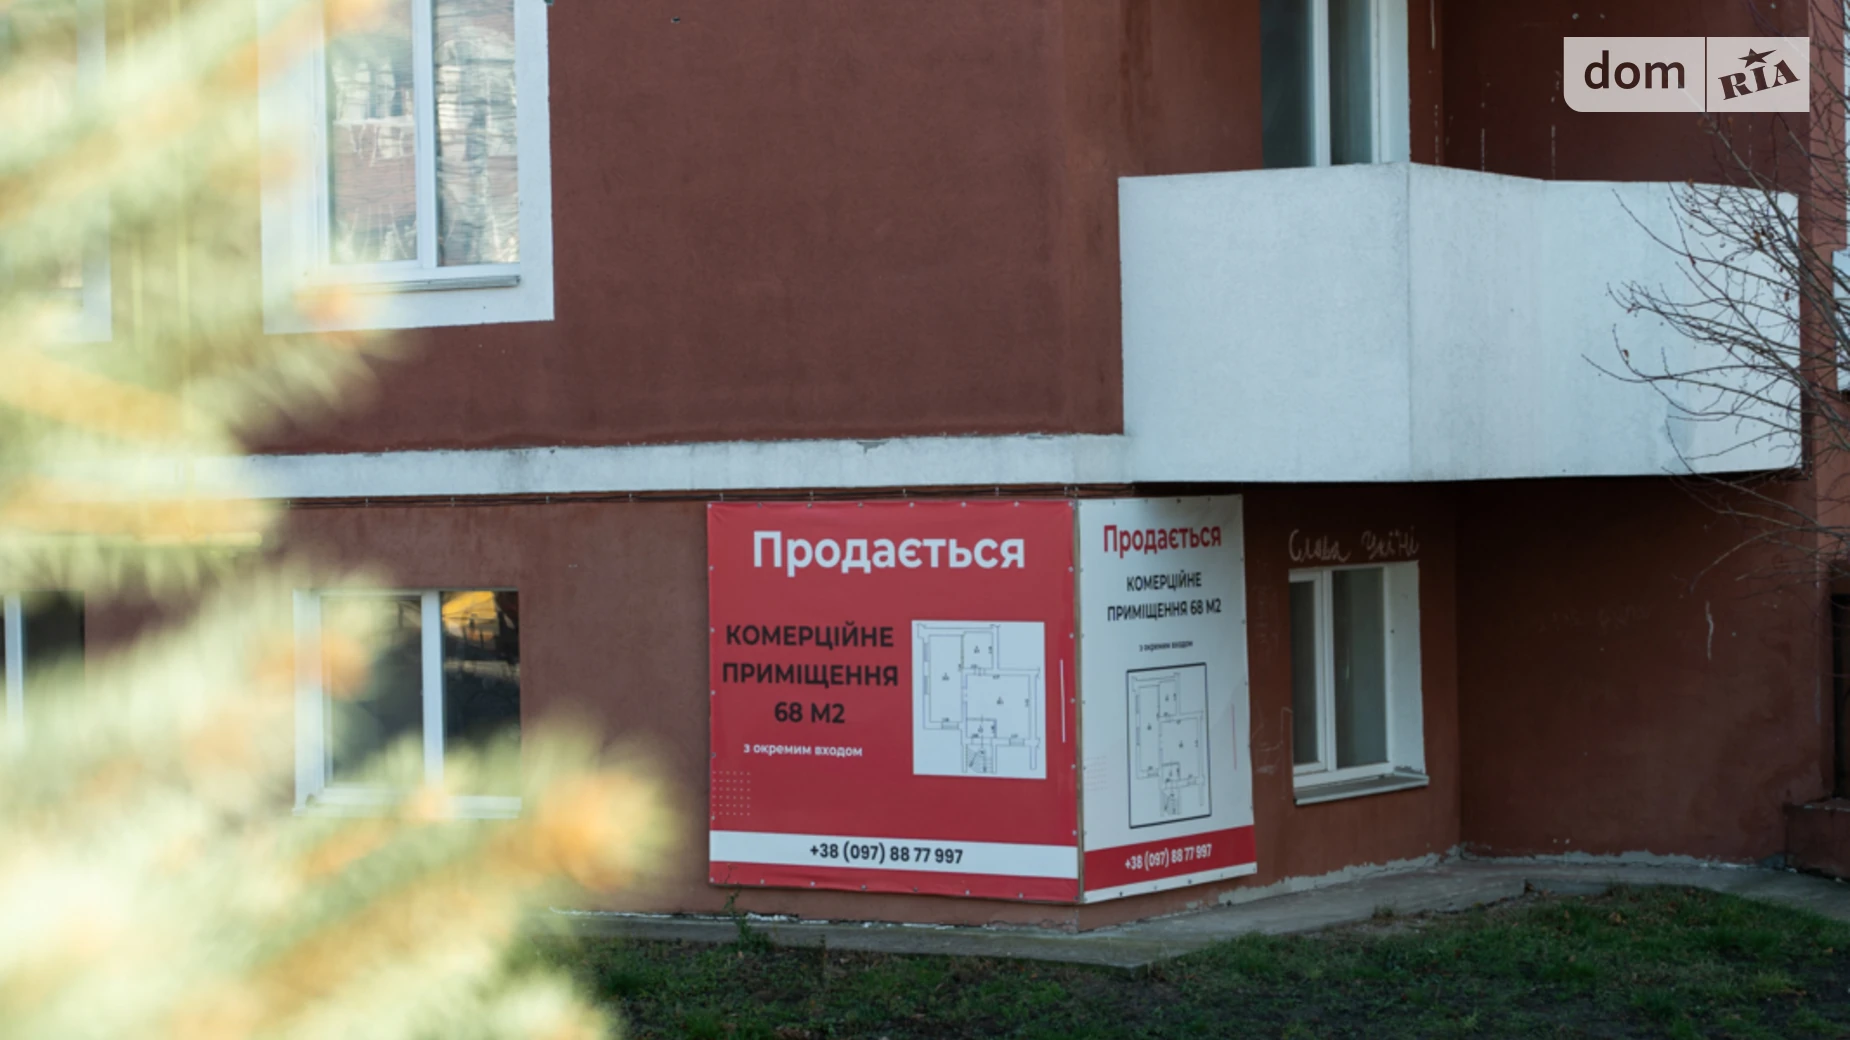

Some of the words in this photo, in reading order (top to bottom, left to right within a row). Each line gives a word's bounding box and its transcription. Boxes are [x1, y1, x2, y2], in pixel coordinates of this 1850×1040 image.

[753, 530, 1025, 577] Продається
[1103, 524, 1222, 559] Продається
[1126, 569, 1202, 592] КОМЕРЦІЙНЕ
[1107, 601, 1188, 621] ПРИМІЩЕННЯ
[1190, 598, 1204, 615] 68
[726, 621, 894, 651] КОМЕРЦІЙНЕ
[722, 664, 899, 688] ПРИМІЩЕННЯ
[774, 702, 803, 723] 68
[743, 744, 750, 754] з
[753, 744, 812, 759] окремим
[815, 745, 863, 759] входом
[810, 842, 839, 859] +38
[843, 841, 886, 864] (097)
[890, 845, 911, 863] 88
[913, 847, 933, 863] 77
[934, 848, 964, 865] 997
[1125, 855, 1143, 870] +38
[1144, 848, 1170, 871] (097)
[1171, 849, 1183, 863] 88
[1184, 846, 1194, 861] 77
[1196, 843, 1212, 860] 997
